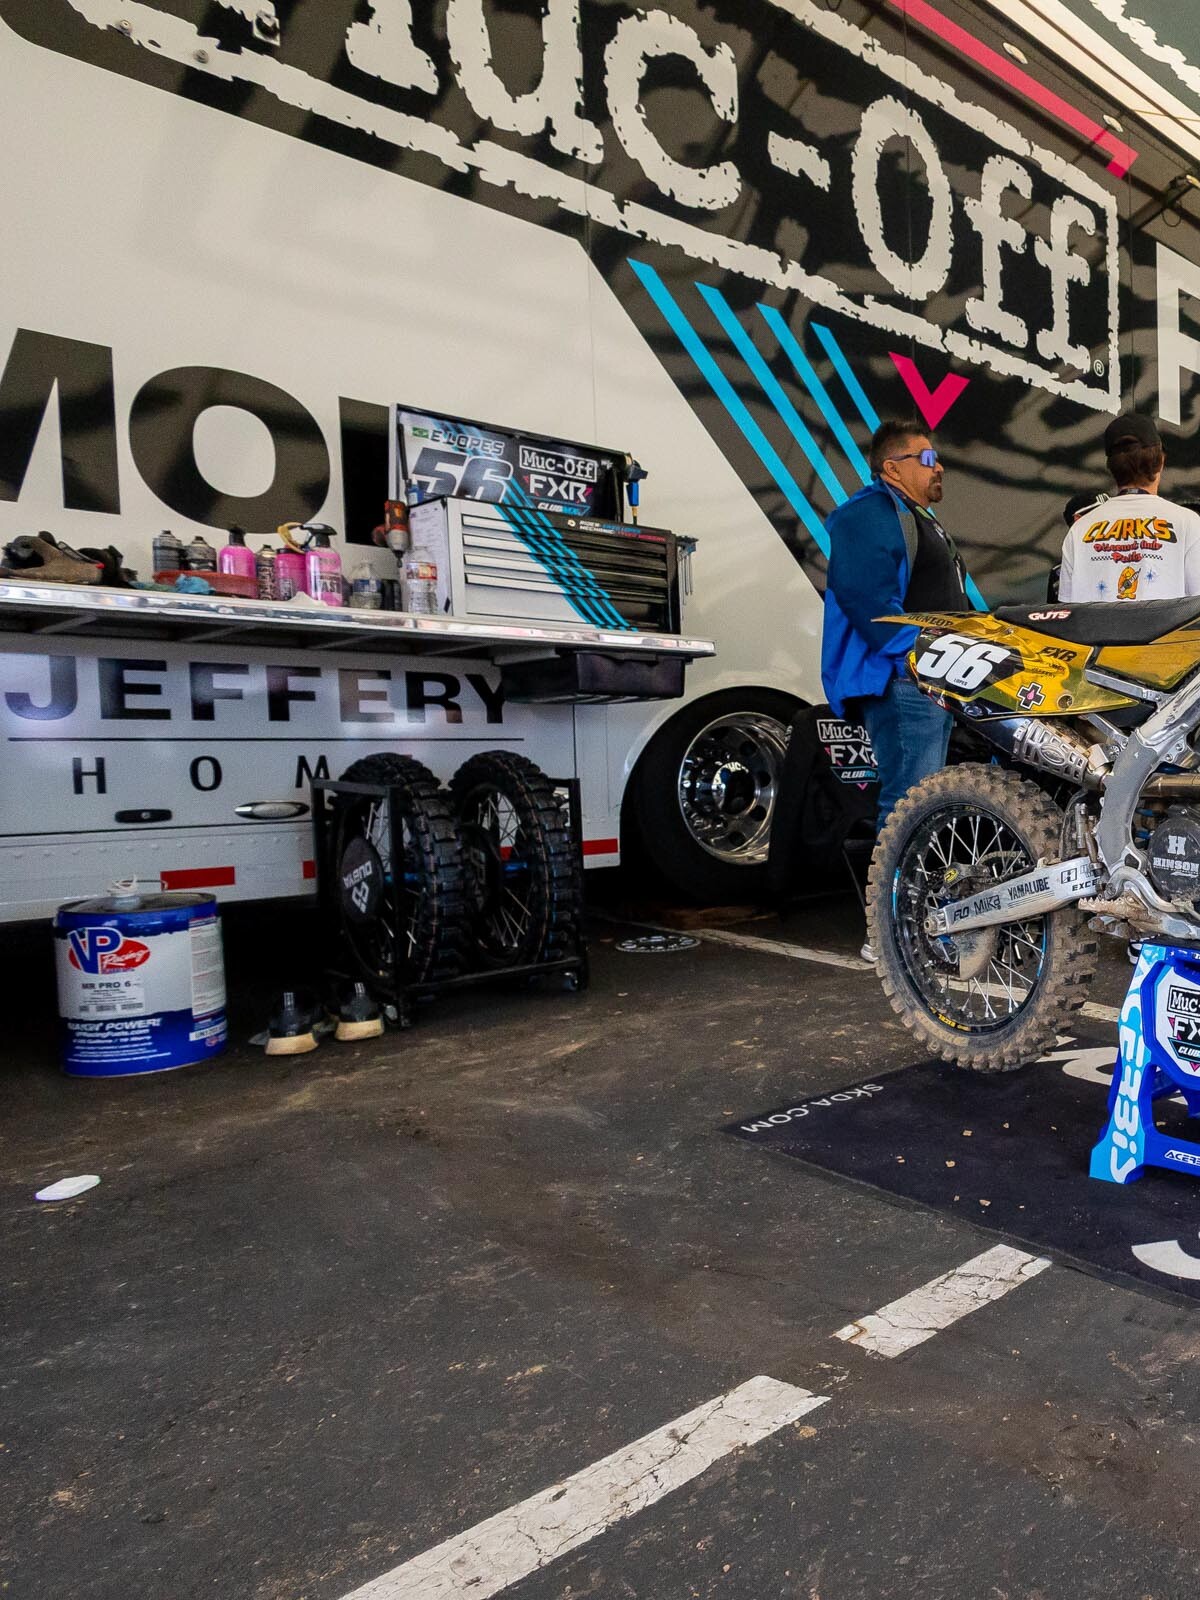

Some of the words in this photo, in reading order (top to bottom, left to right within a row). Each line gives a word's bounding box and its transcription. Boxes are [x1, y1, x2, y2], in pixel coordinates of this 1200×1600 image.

[412, 447, 513, 504] 56
[522, 450, 593, 480] Muc-Off
[529, 474, 586, 503] FXR
[1082, 515, 1178, 543] CLARK'S
[907, 613, 955, 629] DUNLOP
[1028, 611, 1073, 621] GUTS
[916, 633, 1011, 691] 56
[2, 652, 514, 725] JEFFERY
[1153, 857, 1200, 873] HINSON
[1007, 876, 1050, 901] YAMALUBE
[1071, 878, 1099, 892] EXCE
[68, 926, 122, 975] VP
[102, 949, 148, 968] Racing
[99, 981, 121, 989] PRO
[740, 1083, 885, 1134] SKDA.COM
